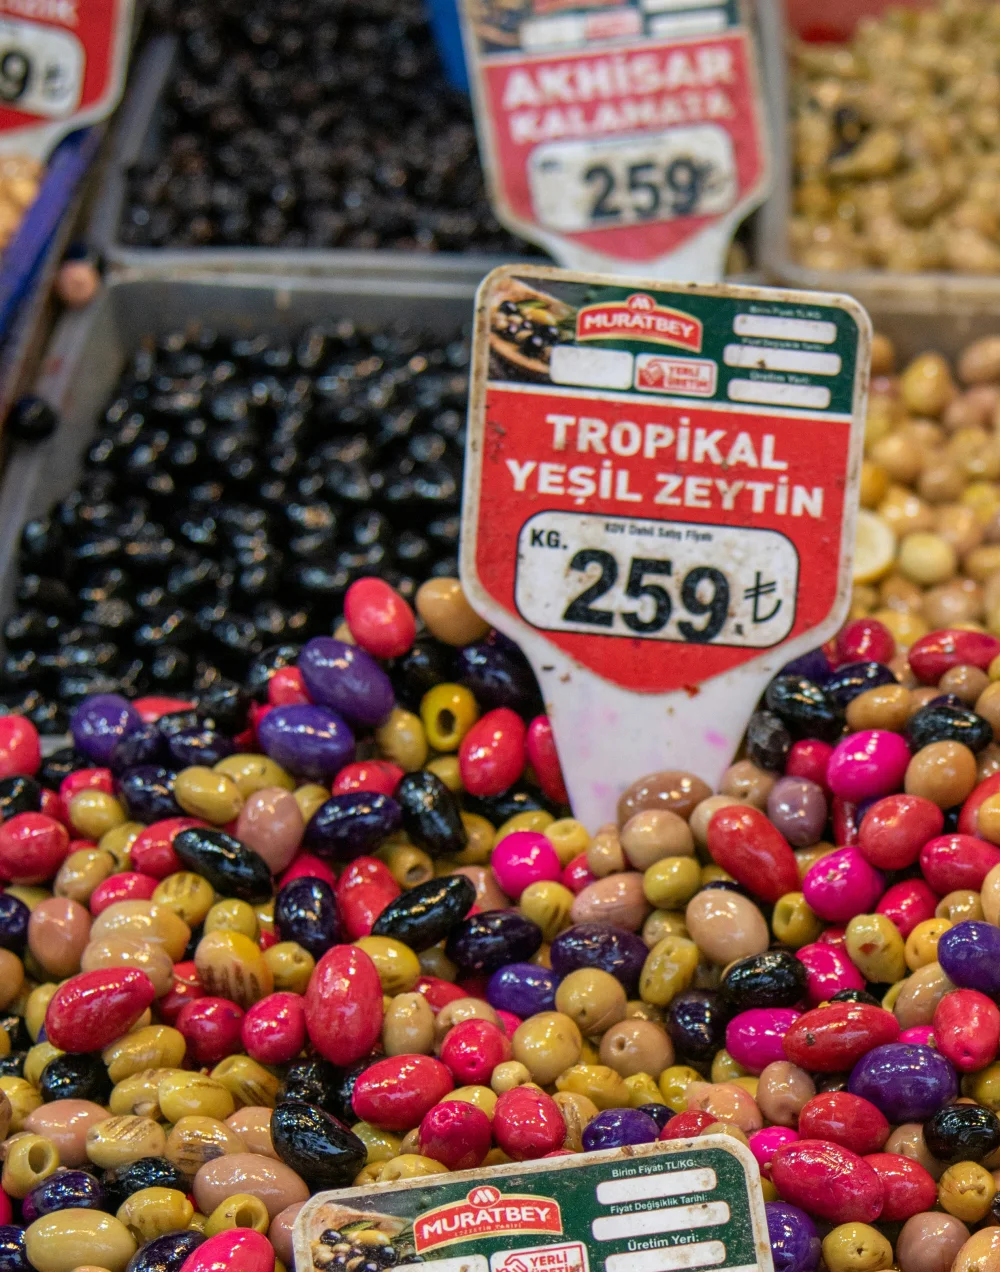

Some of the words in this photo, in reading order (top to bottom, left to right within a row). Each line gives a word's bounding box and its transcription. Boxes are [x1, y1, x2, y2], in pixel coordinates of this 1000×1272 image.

[584, 157, 698, 219] 259
[584, 313, 694, 338] MURATBEY
[546, 414, 788, 470] TROPİKAL
[506, 459, 643, 505] YEŞİL
[653, 475, 824, 518] ZEYTİN
[530, 529, 568, 550] KG.
[562, 548, 730, 643] 259
[612, 1167, 637, 1178] Birim
[639, 1164, 663, 1174] Fiyatı
[665, 1159, 697, 1170] TL/KG:
[610, 1204, 632, 1215] Fiyat
[635, 1197, 678, 1210] Değişiklik
[680, 1193, 708, 1204] Tarihi:
[423, 1206, 551, 1240] MURATBEY
[627, 1240, 669, 1252] Üretim
[671, 1233, 700, 1244] Yeri:
[530, 1250, 567, 1267] YERLİ
